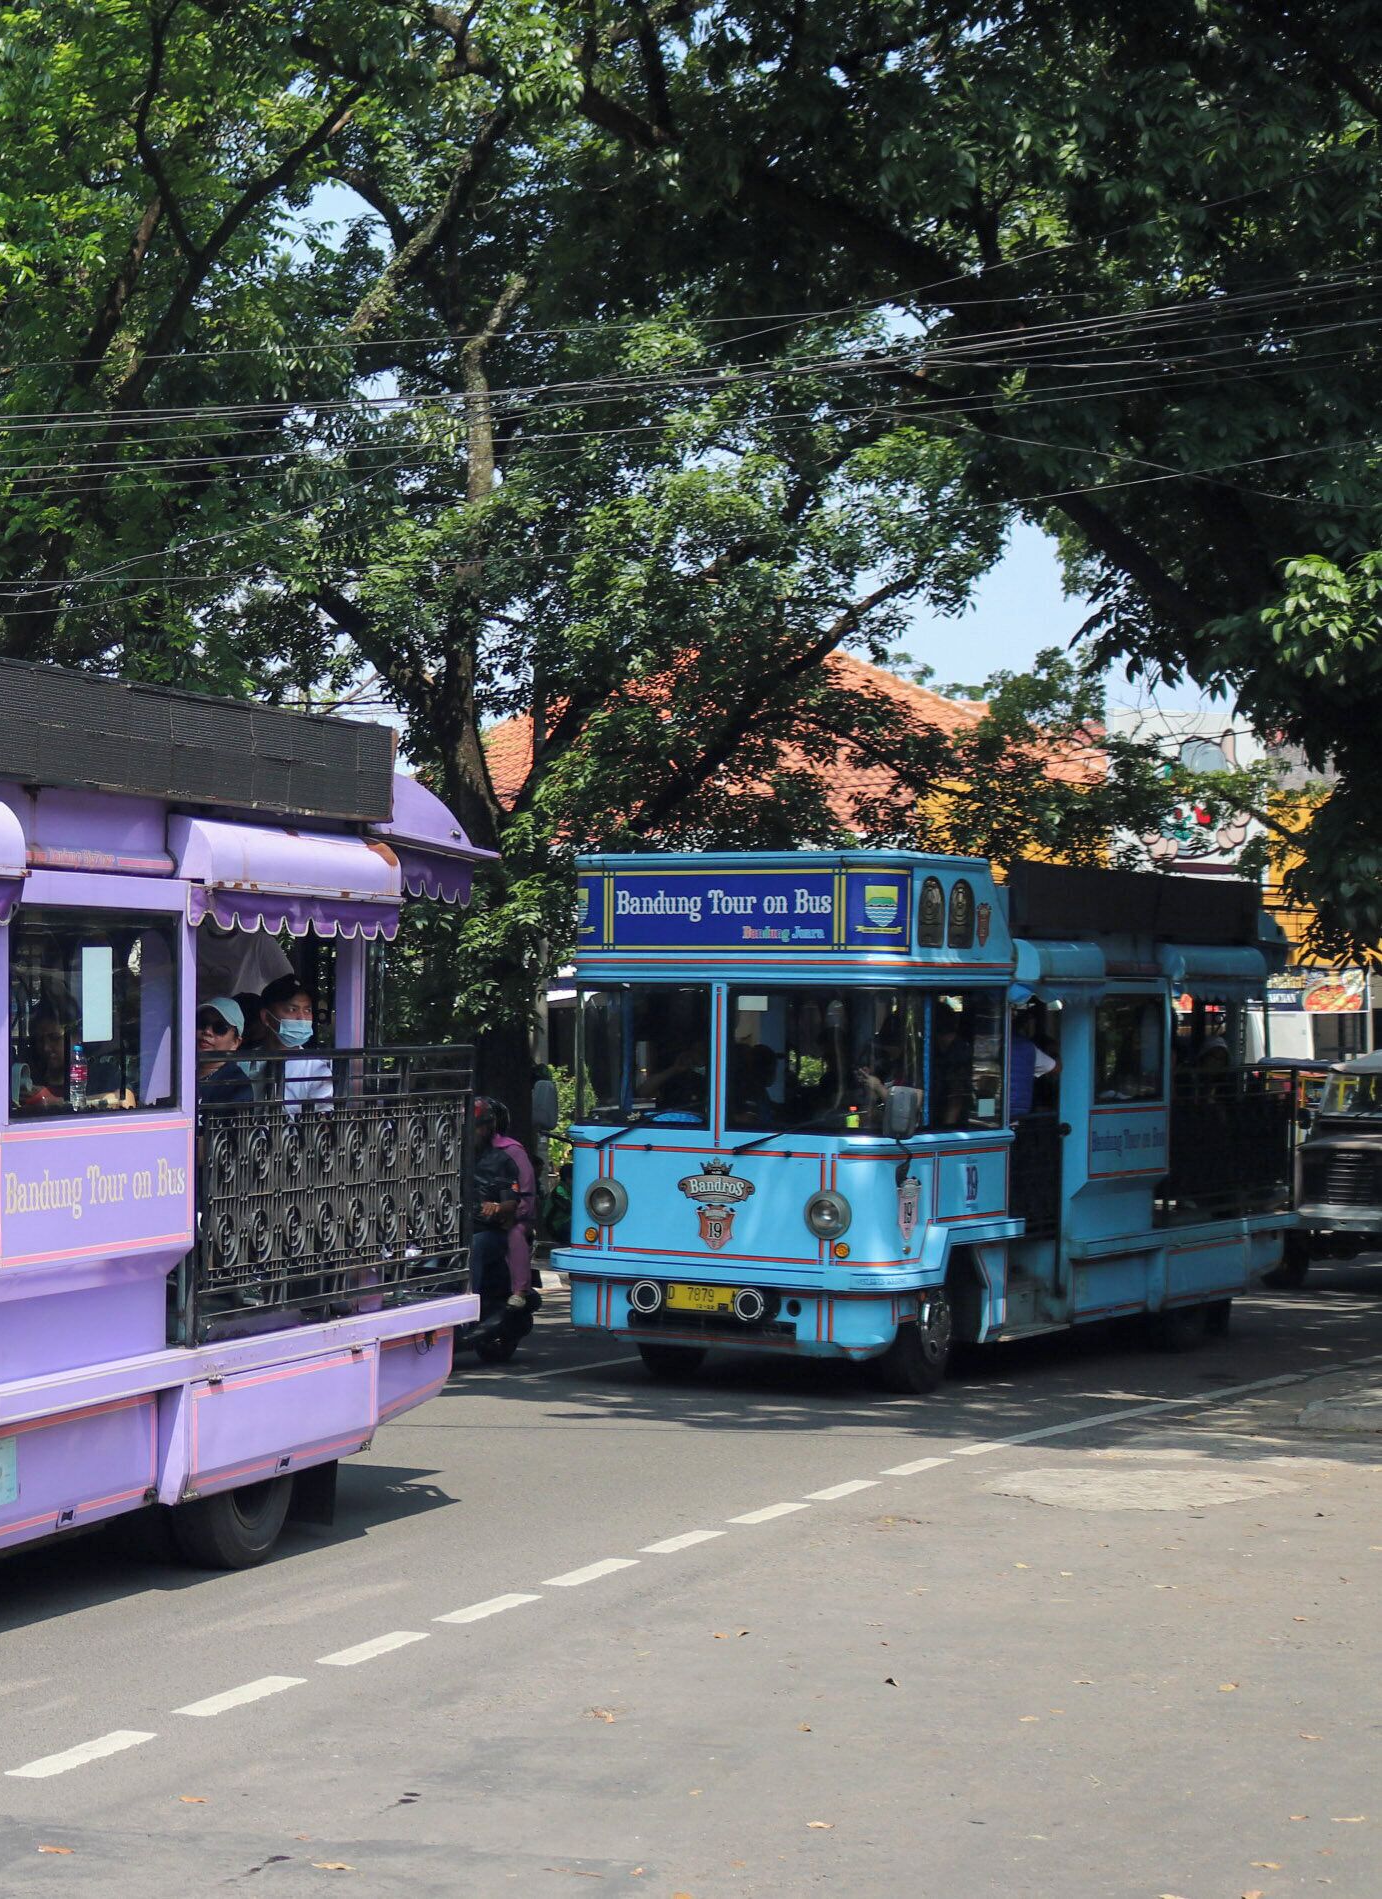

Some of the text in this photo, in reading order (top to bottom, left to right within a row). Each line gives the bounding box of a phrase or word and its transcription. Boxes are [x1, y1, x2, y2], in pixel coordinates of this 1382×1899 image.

[616, 889, 833, 922] Bandung Tour on Bus
[5, 1157, 186, 1219] Bandung Tour on Bus
[689, 1178, 745, 1197] Bandros
[709, 1222, 723, 1239] 19
[668, 1286, 675, 1300] D
[687, 1287, 715, 1303] 7879
